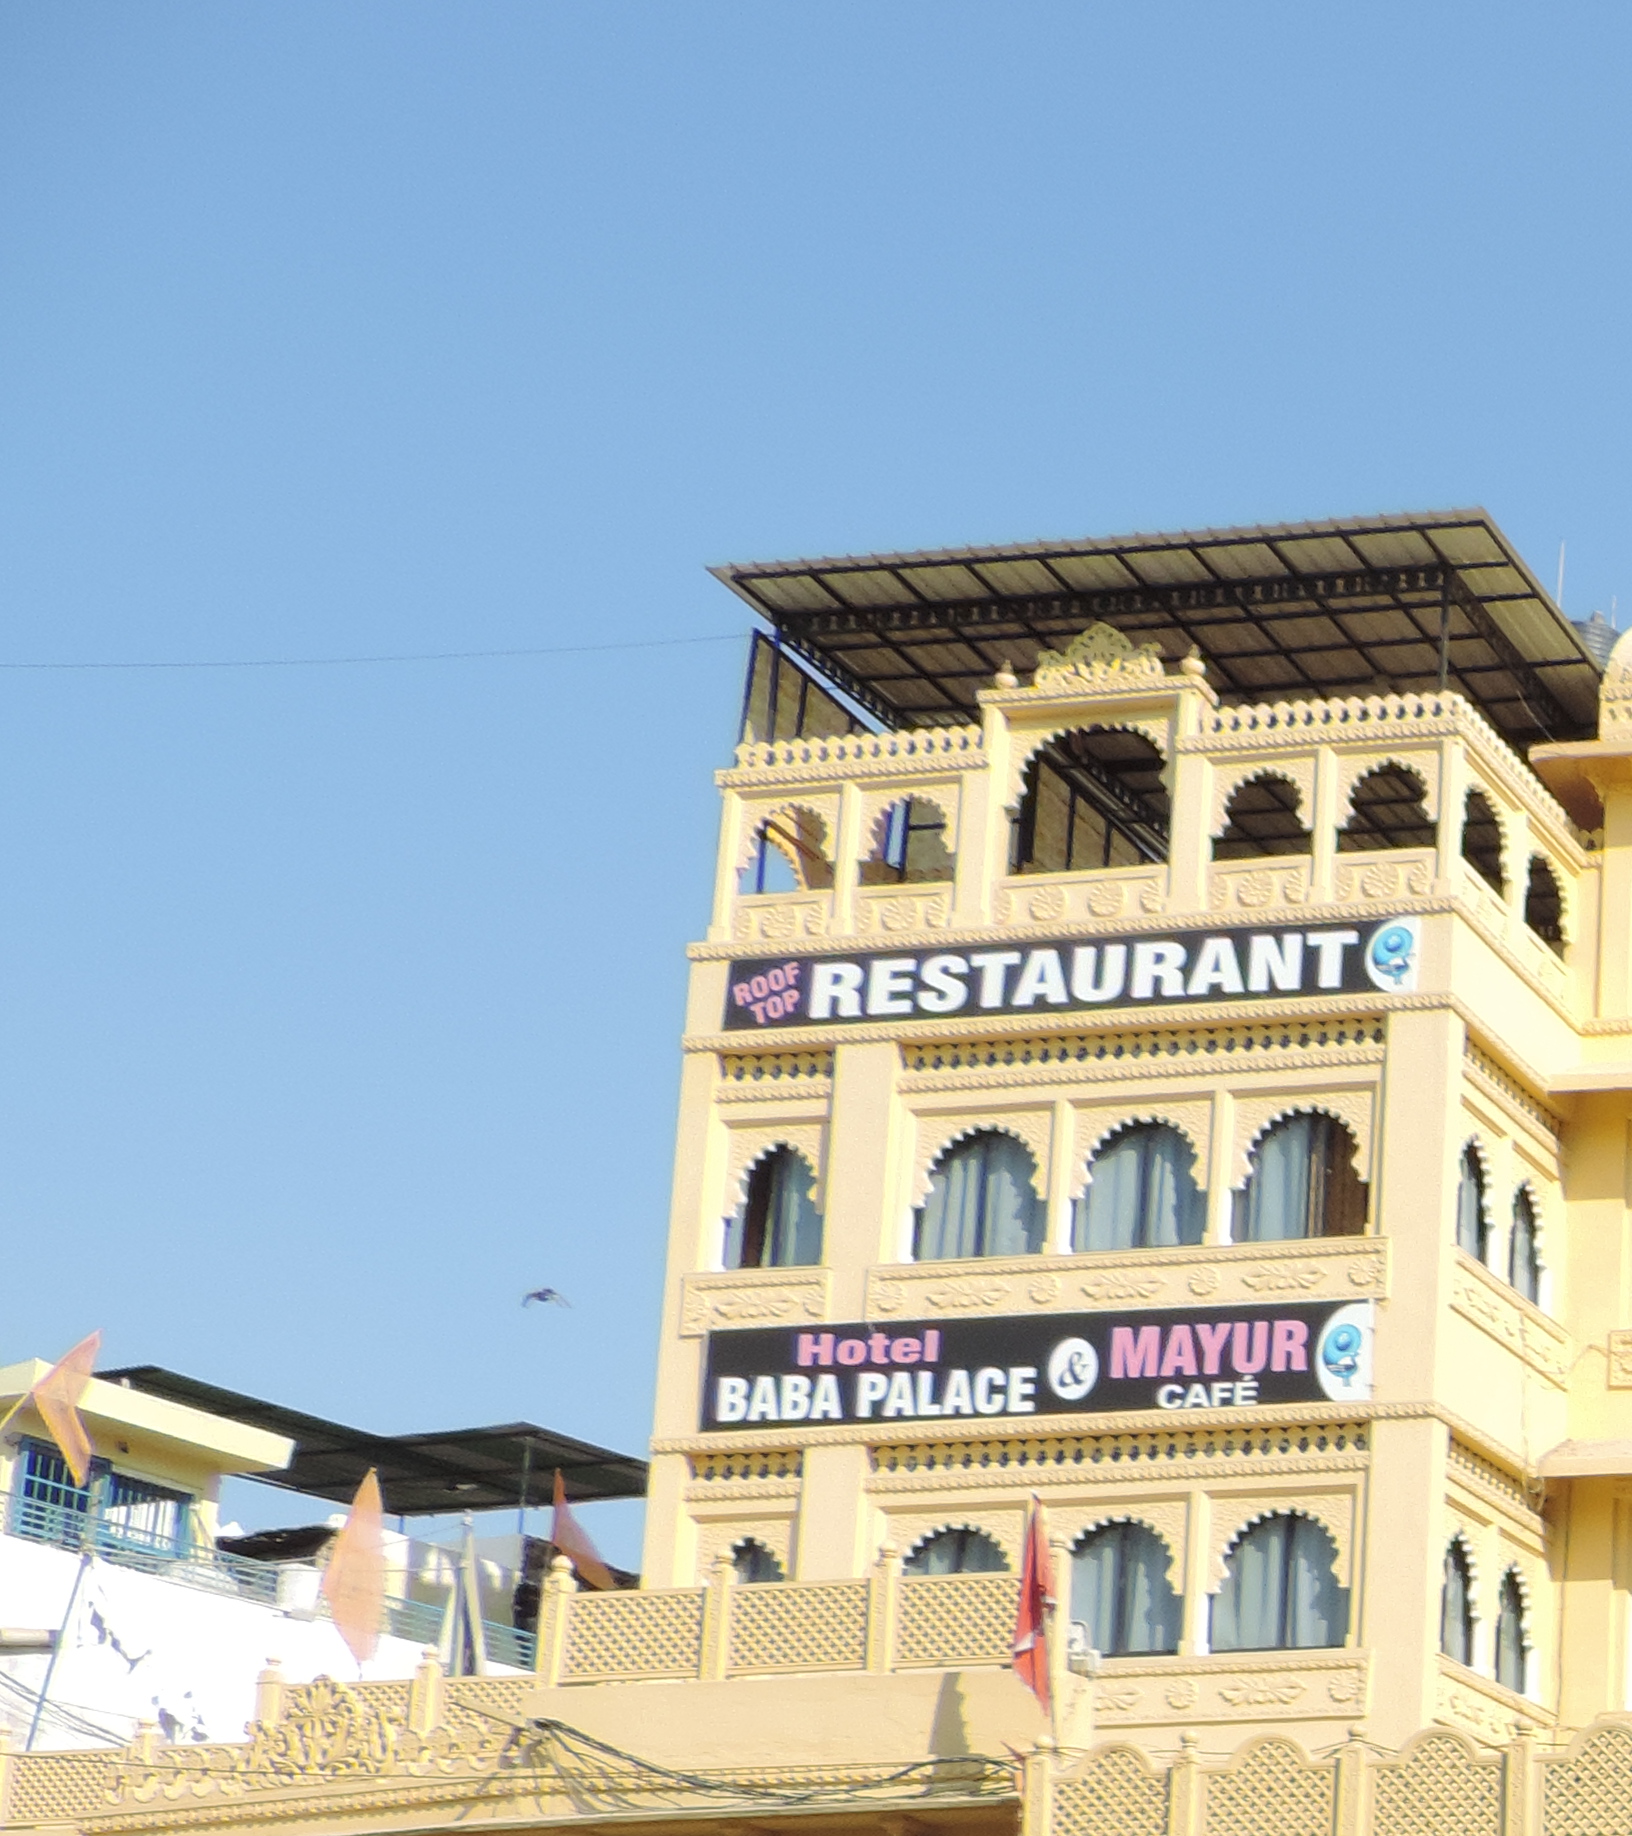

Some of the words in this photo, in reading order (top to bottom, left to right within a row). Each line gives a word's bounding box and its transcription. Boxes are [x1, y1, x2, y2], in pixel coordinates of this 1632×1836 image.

[732, 961, 802, 1007] ROOF
[807, 930, 1360, 1020] RESTAURANT
[750, 990, 801, 1027] TOP
[796, 1330, 940, 1367] Hotel
[1110, 1320, 1309, 1380] MAYUR
[715, 1373, 843, 1423] BABA
[856, 1366, 1038, 1418] PALACE
[1058, 1350, 1089, 1386] &
[1156, 1374, 1260, 1411] CAFÉ
